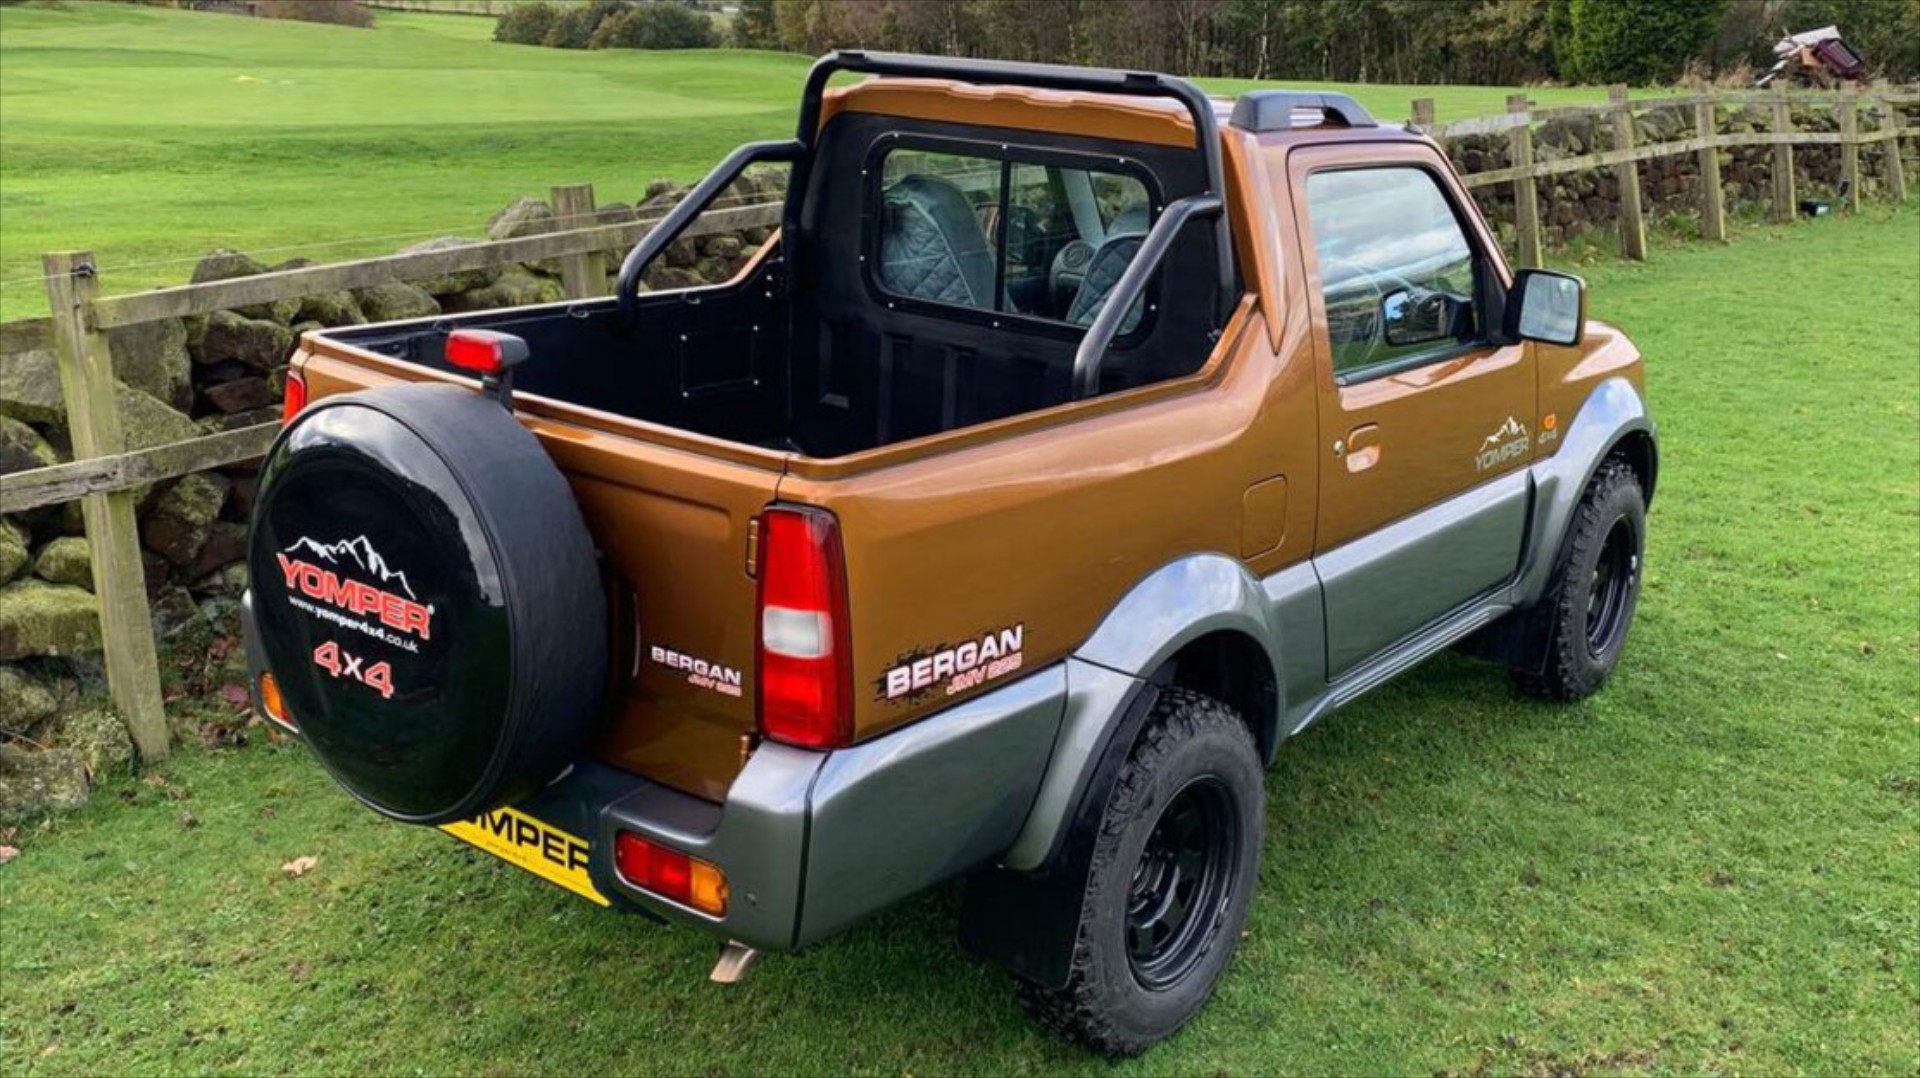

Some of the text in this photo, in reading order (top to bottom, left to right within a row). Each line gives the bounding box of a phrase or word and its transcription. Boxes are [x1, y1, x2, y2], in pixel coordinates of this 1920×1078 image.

[276, 552, 430, 640] YOMPER
[288, 596, 418, 653] www.yomper4x4.co.uk
[651, 646, 741, 685] BERGAN
[887, 624, 1023, 698] BERGAN
